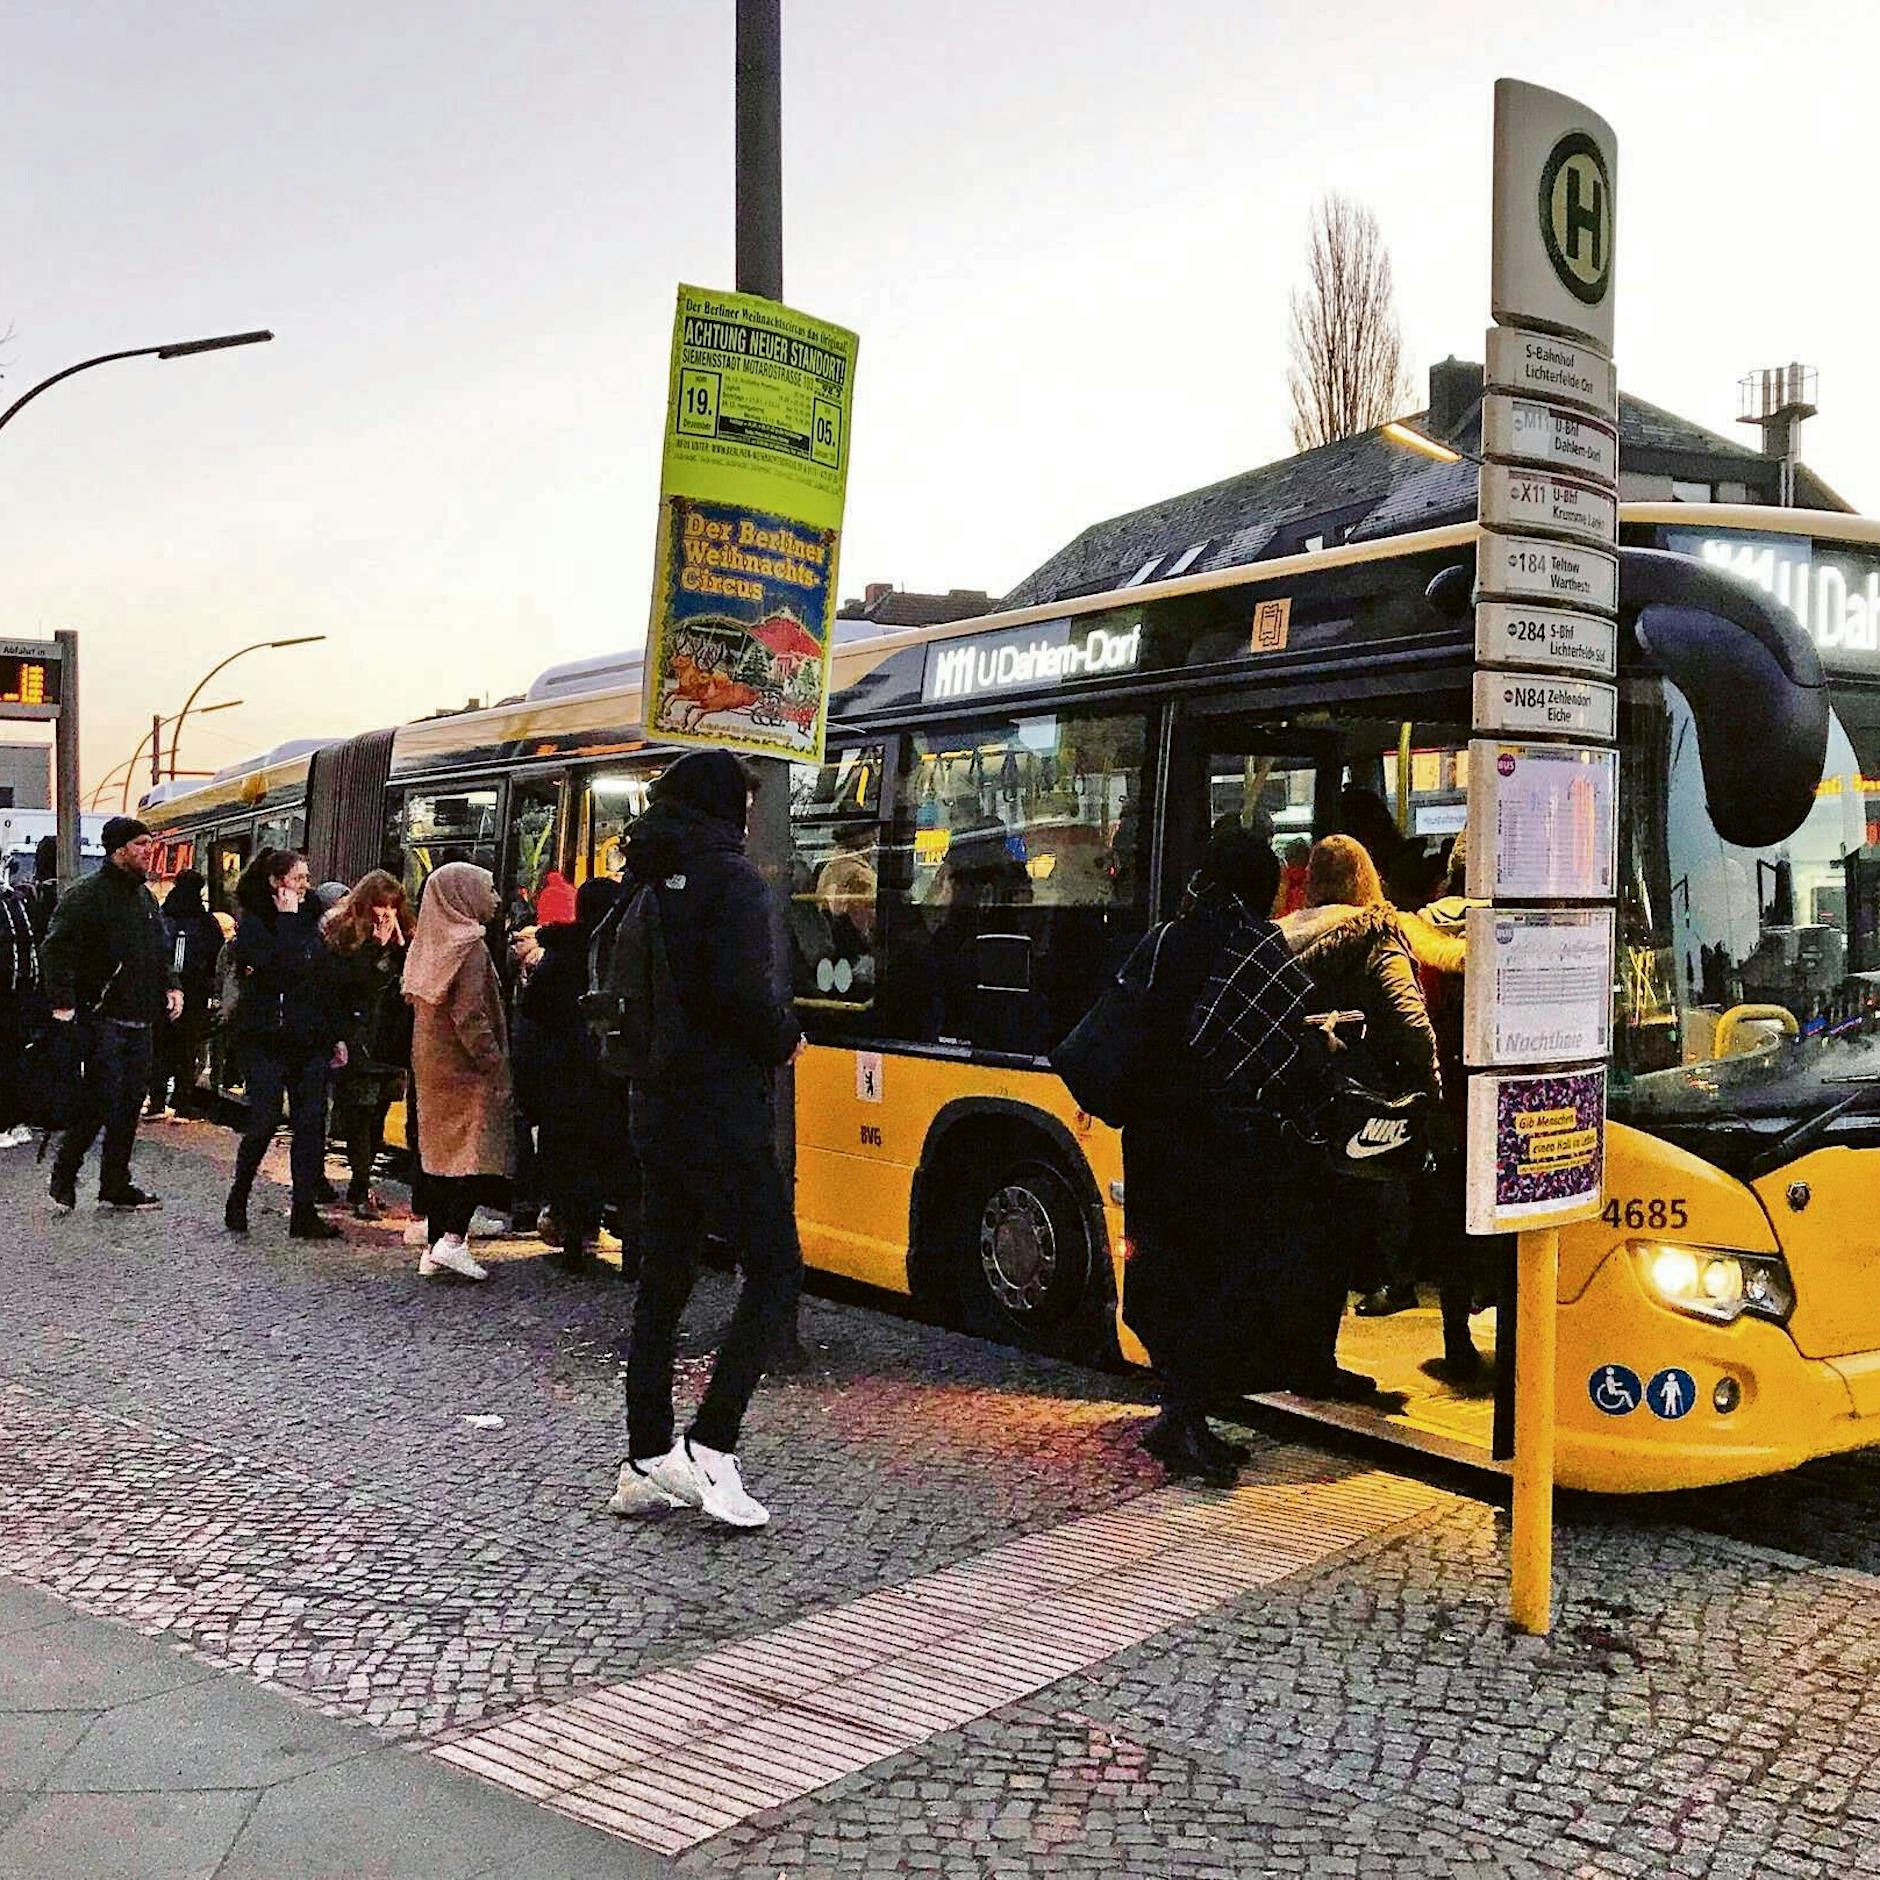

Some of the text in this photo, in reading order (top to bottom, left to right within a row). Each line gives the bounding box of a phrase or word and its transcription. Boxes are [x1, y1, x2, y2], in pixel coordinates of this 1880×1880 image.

[1565, 166, 1601, 271] H
[686, 298, 701, 311] Der
[704, 300, 740, 320] Berliner
[683, 349, 741, 371] SIEMENSSTADT
[685, 319, 747, 353] ACHTUNG
[749, 330, 789, 363] NEUER
[790, 340, 845, 384] STANDORT!
[1526, 344, 1574, 368] S-Bahnhof
[1525, 363, 1579, 390] Lichterfelde
[687, 387, 712, 415] 19.
[817, 417, 836, 447] 05.
[1554, 436, 1601, 462] Dahlem-Dorf
[1521, 482, 1546, 504] X11
[1553, 487, 1579, 505] U-Bhf
[685, 512, 825, 564] Der Berliner
[1519, 552, 1546, 574] 184
[1551, 556, 1580, 574] Teltow
[680, 566, 765, 602] Circus
[1518, 620, 1546, 642] 284
[1550, 624, 1574, 640] S-Bhf
[979, 647, 998, 686] U
[998, 622, 1143, 684] Dahlem-Dorf
[1550, 641, 1595, 660] Lichterfelde
[1515, 687, 1546, 708] N84
[1547, 689, 1591, 707] Zehlendorf
[1548, 707, 1572, 722] Eiche
[1359, 1118, 1409, 1143] NIKE
[1519, 1114, 1574, 1129] Gib Menschen
[860, 1125, 882, 1146] BVG
[1602, 1198, 1688, 1230] 4685
